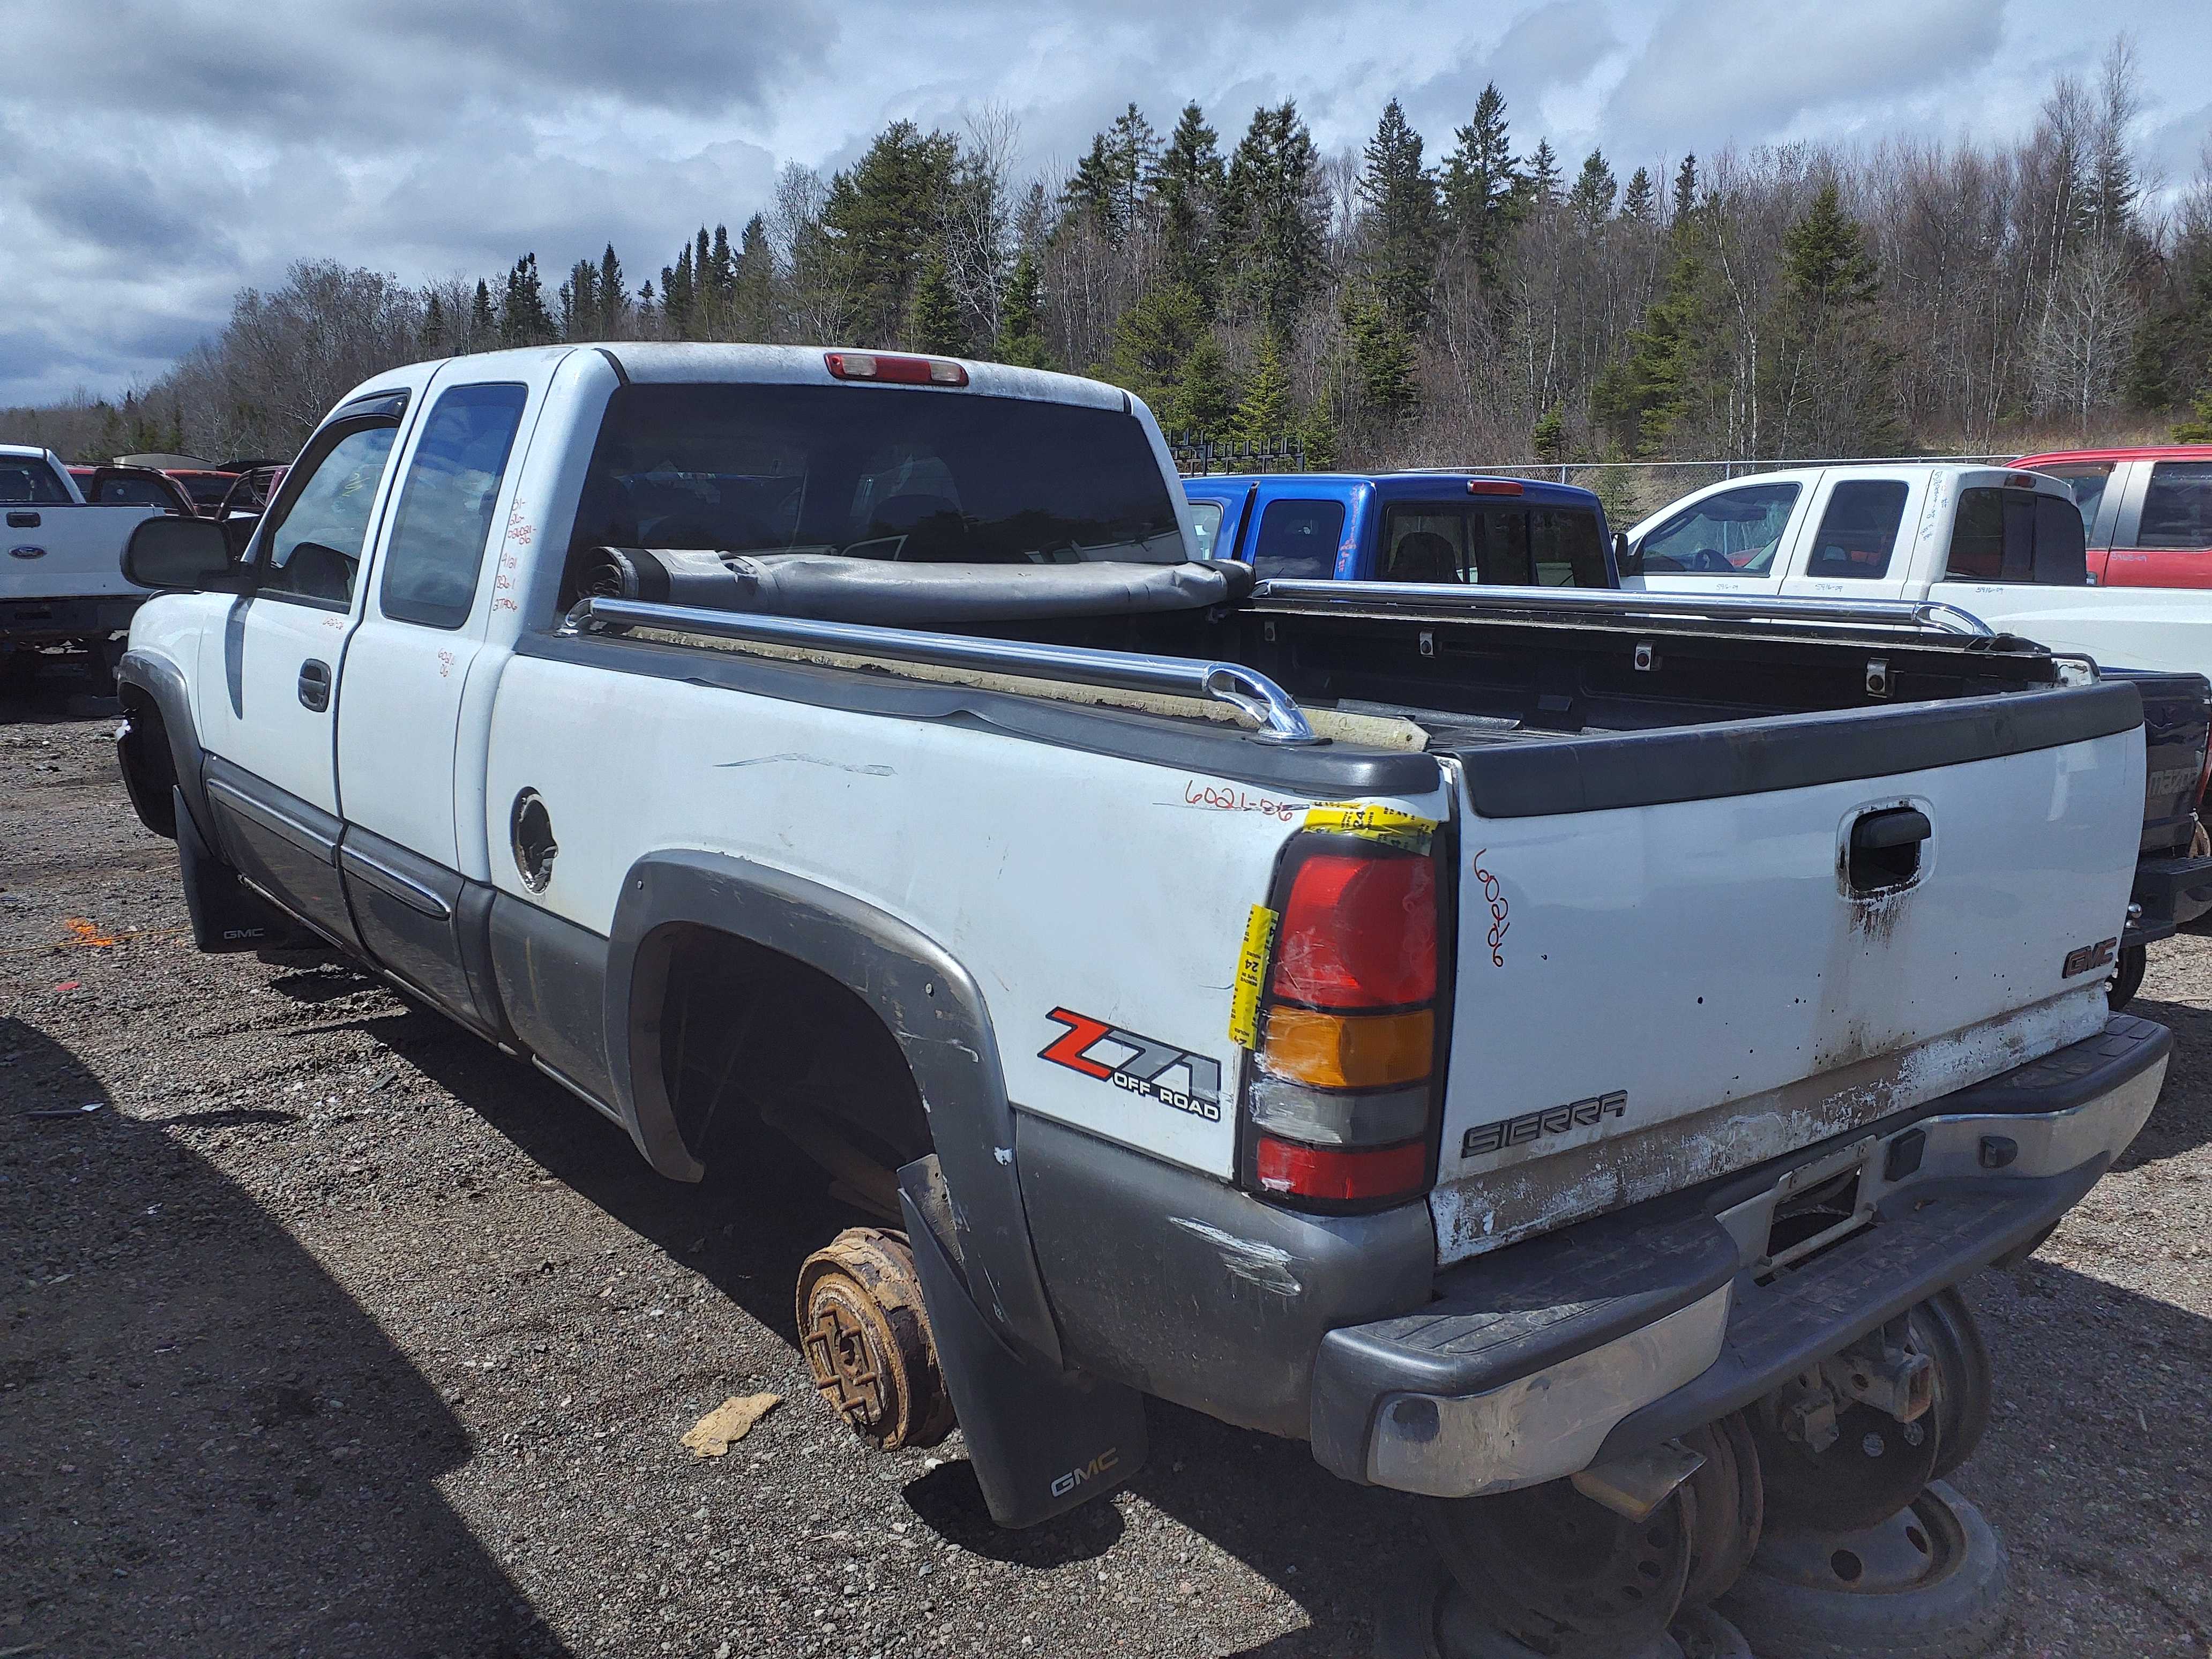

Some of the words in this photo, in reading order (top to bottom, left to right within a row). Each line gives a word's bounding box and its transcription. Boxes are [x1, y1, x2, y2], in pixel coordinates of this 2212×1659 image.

[1185, 780, 1294, 821] 6021-06
[223, 928, 265, 939] GMC
[1245, 958, 1259, 972] 24
[2062, 937, 2117, 980] GMC
[1037, 1006, 1222, 1105] Z71
[1113, 1071, 1151, 1094] OFF
[1160, 1087, 1220, 1121] ROAD
[1461, 1089, 1628, 1158] SIERRA
[1051, 1447, 1120, 1497] GMC
